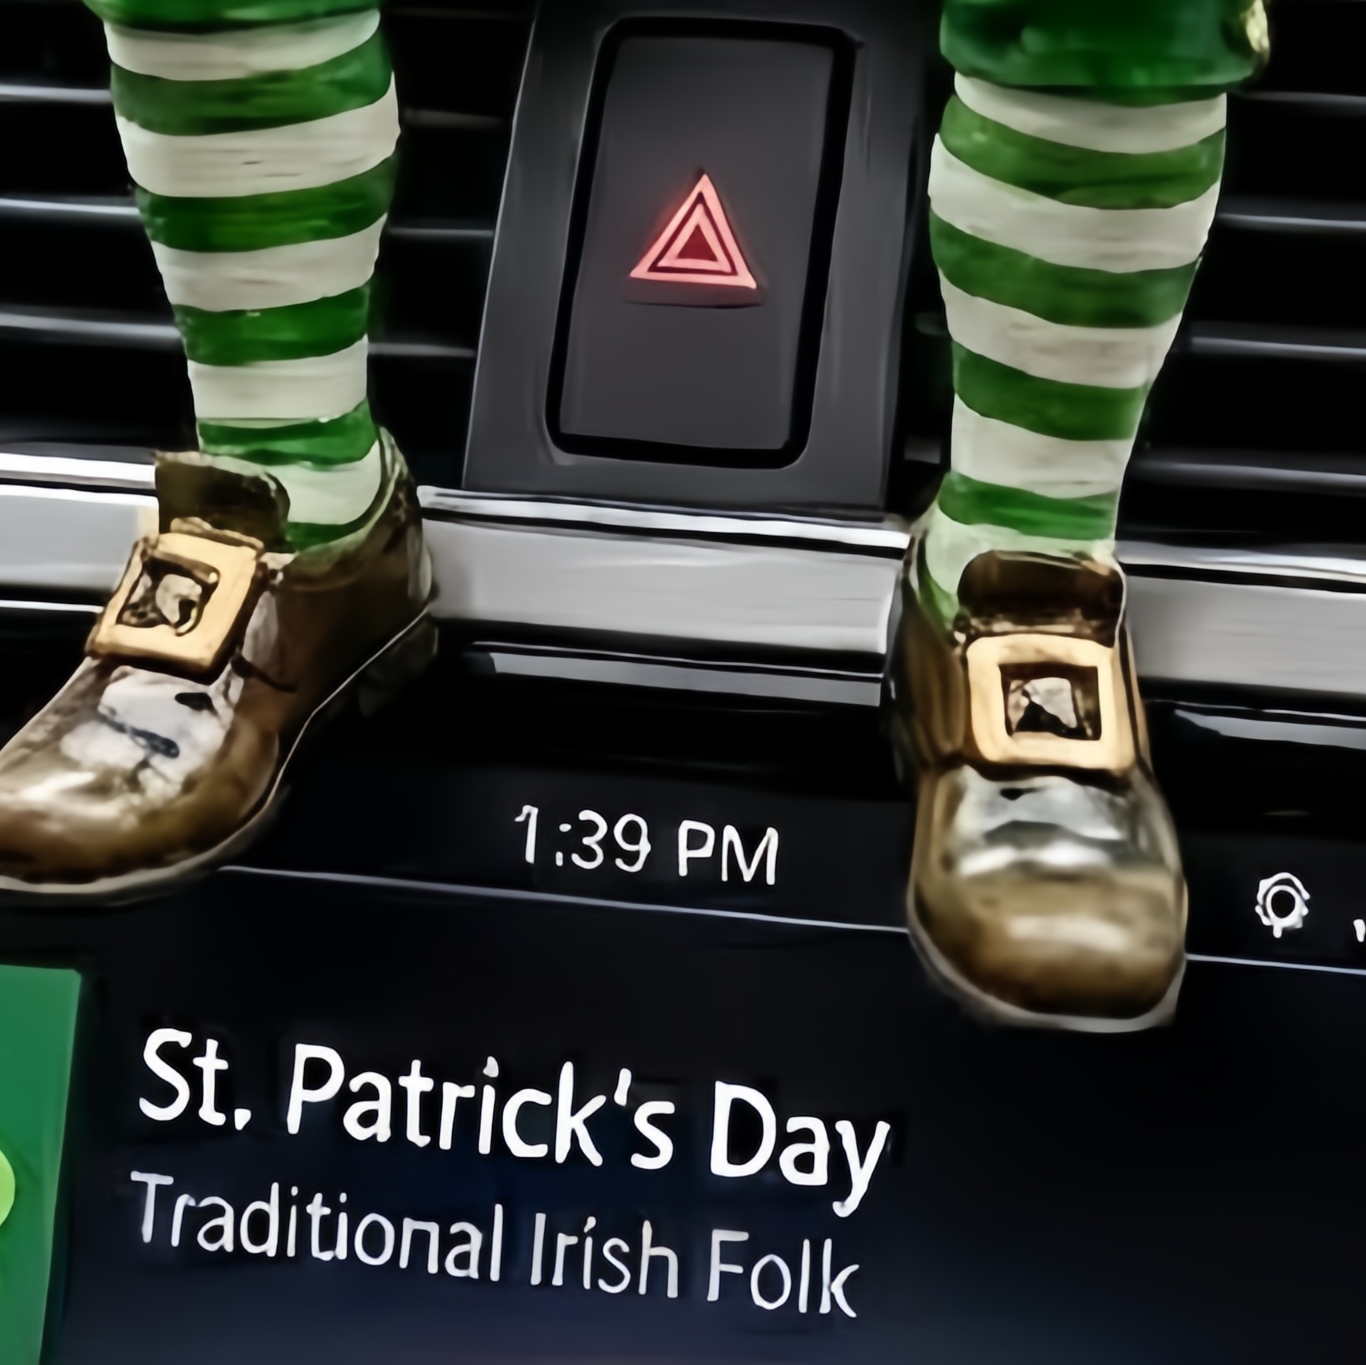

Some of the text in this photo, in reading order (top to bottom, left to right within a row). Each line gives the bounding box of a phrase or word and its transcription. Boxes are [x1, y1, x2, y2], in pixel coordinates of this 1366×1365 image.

[514, 804, 779, 886] 1:39 PM
[138, 1027, 891, 1218] St. Patrick's Day
[130, 1170, 860, 1318] Traditional Irish Folk
